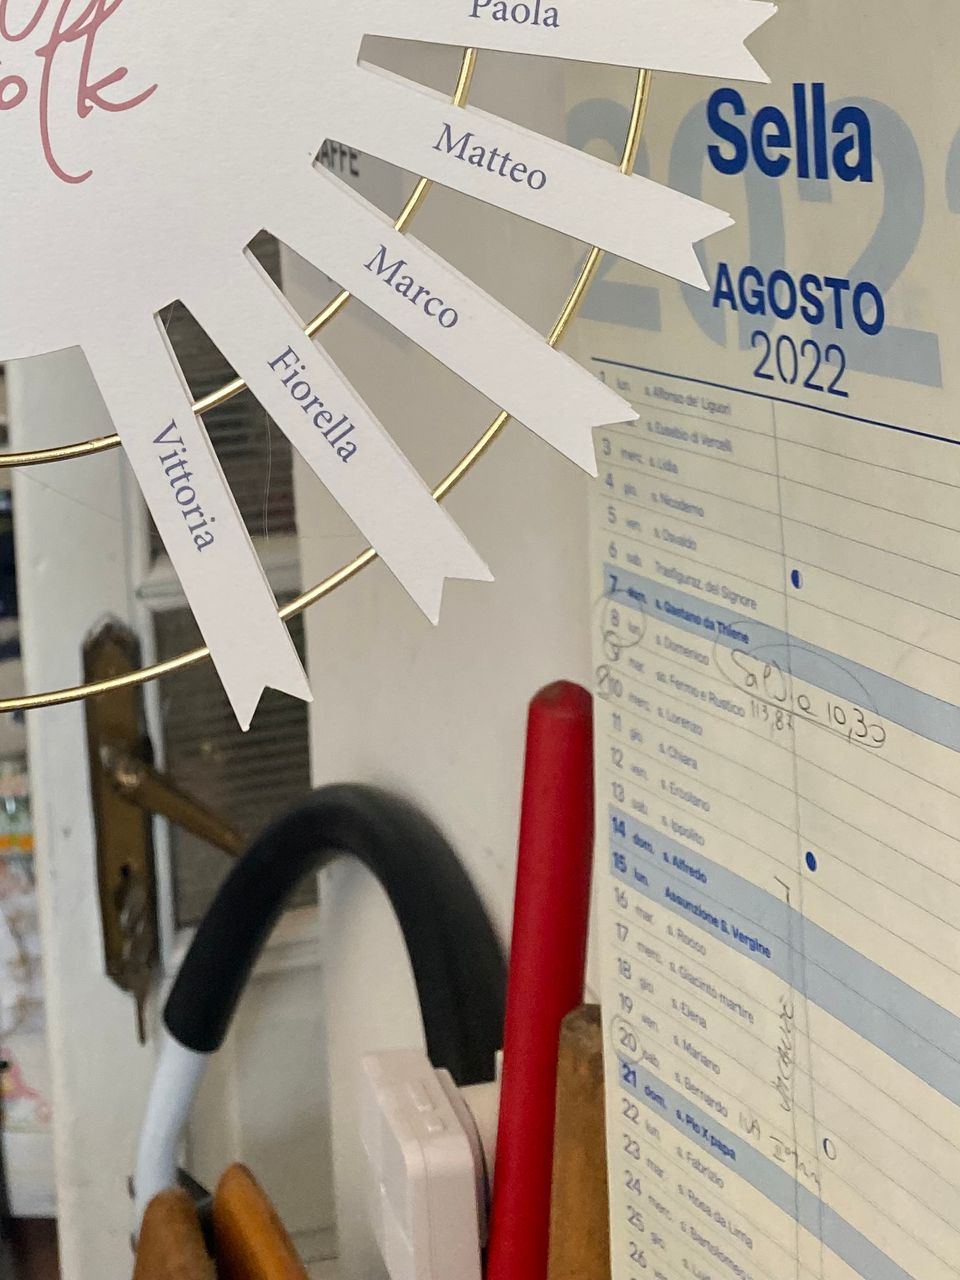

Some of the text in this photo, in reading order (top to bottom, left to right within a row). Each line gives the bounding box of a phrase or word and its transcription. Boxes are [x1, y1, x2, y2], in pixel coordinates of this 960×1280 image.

[706, 82, 874, 183] Sella
[432, 123, 547, 191] Matteo
[363, 244, 459, 329] Marco
[712, 262, 885, 336] AGOSTO
[751, 330, 849, 398] 2022
[266, 346, 358, 464] Fiorella
[602, 437, 612, 456] 3
[152, 419, 216, 553] Vittoria
[604, 472, 614, 489] 4
[607, 505, 617, 525] 5
[608, 541, 618, 559] 6
[609, 574, 619, 594] 7
[610, 746, 623, 769] 12
[612, 816, 626, 838] 14
[612, 852, 627, 874] 15
[731, 925, 771, 959] Vergine
[614, 886, 628, 910] 16
[615, 922, 629, 942] 17
[617, 957, 632, 980] 18
[619, 992, 633, 1014] 19
[619, 1026, 637, 1053] 20
[621, 1060, 637, 1088] 21
[622, 1098, 639, 1125] 22
[623, 1133, 641, 1161] 23
[624, 1169, 642, 1196] 24
[626, 1205, 645, 1233] 25
[629, 1241, 647, 1269] 26
